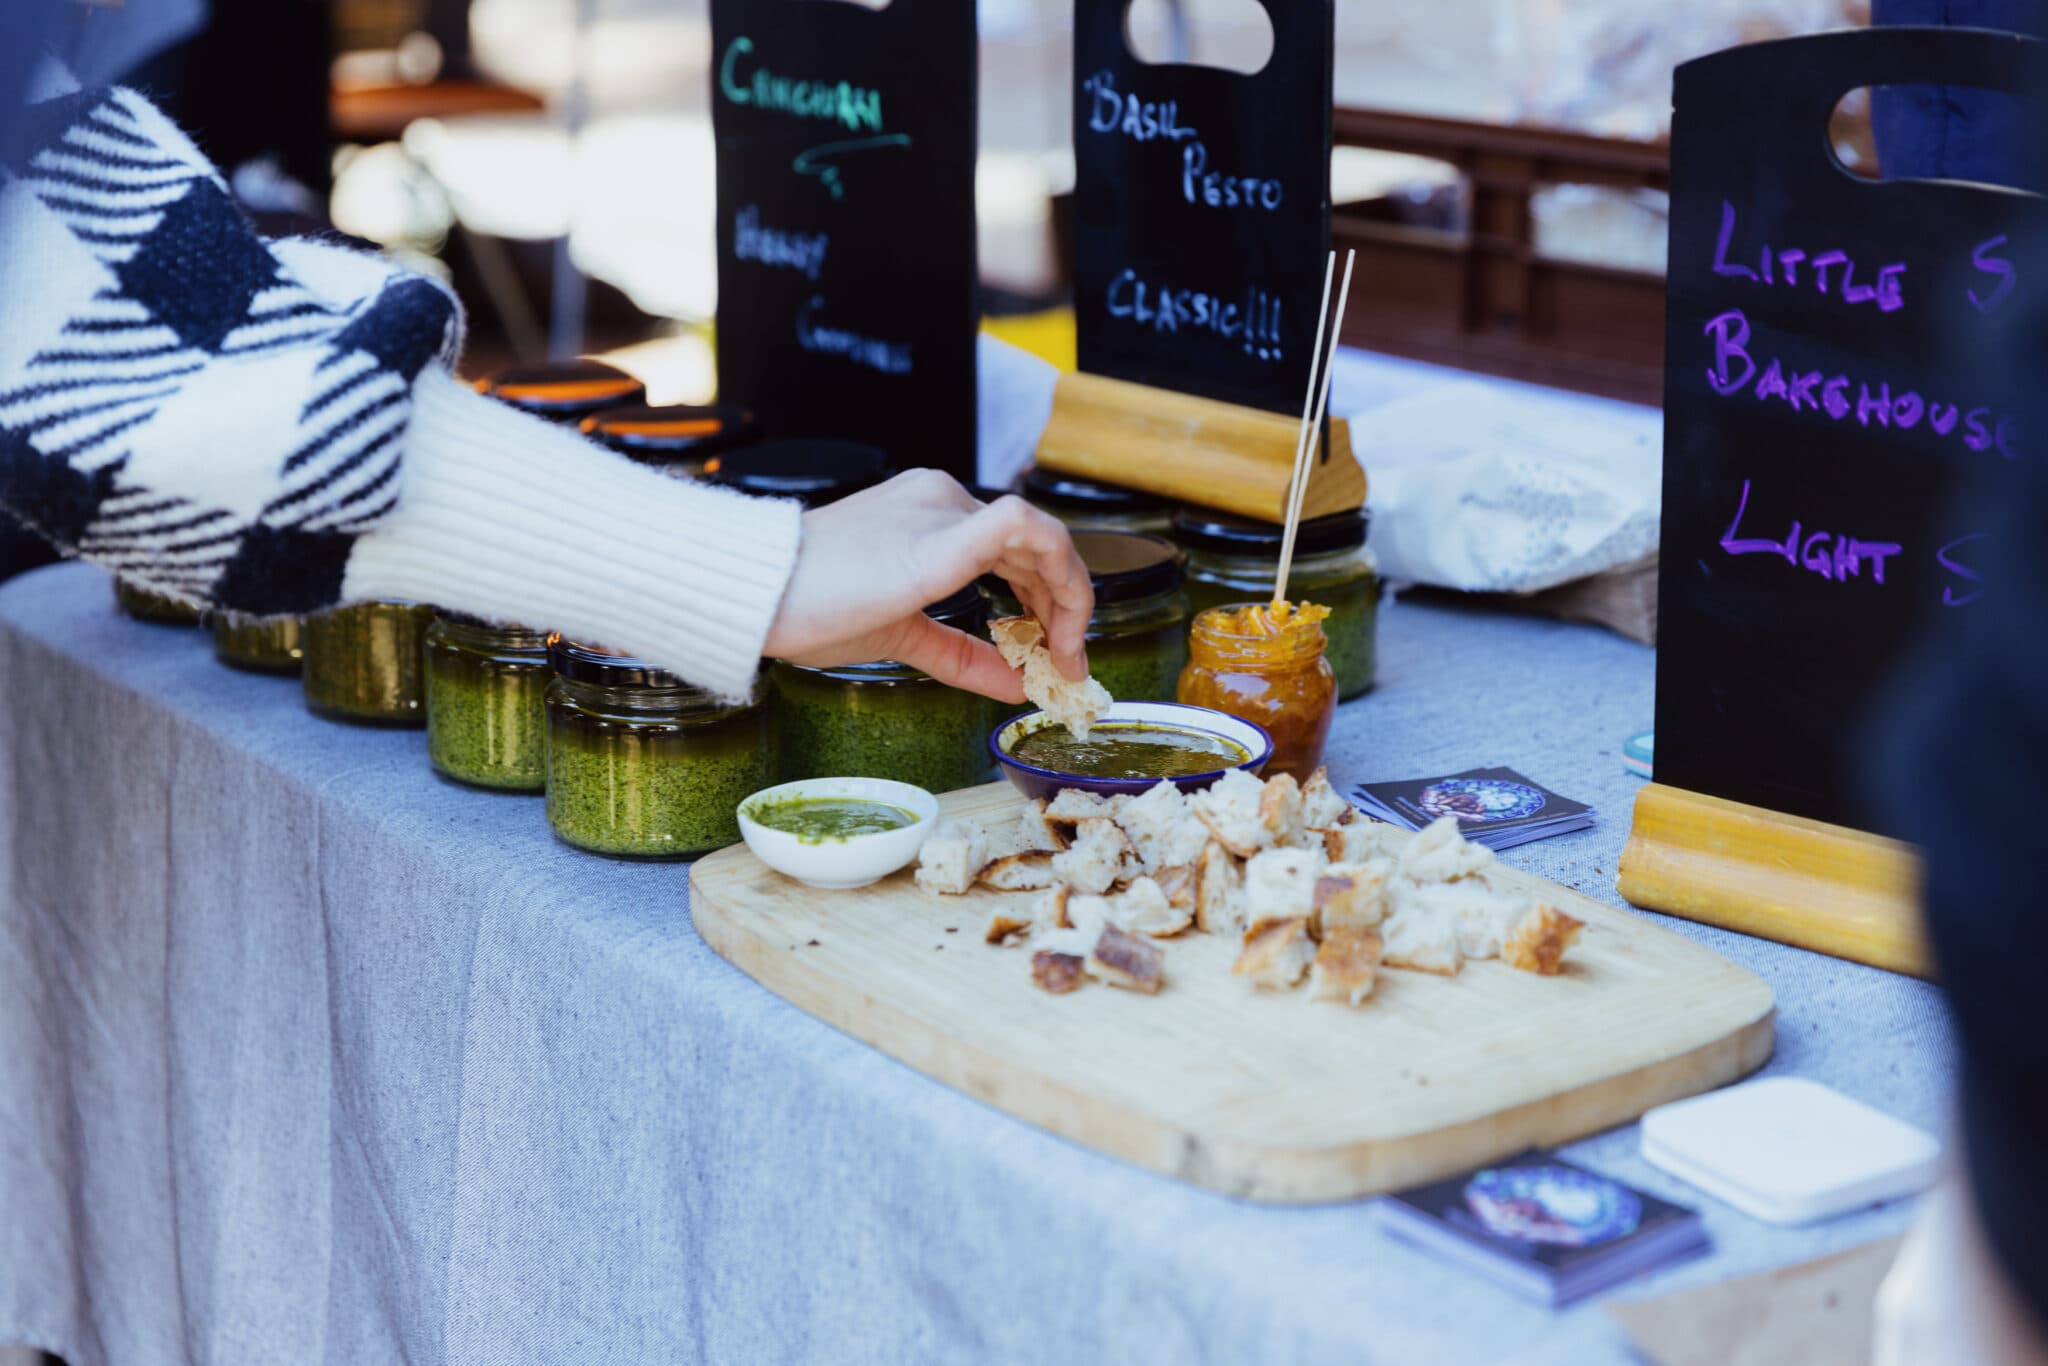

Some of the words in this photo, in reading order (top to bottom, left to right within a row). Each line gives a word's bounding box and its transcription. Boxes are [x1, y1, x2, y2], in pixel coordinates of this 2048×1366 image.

[1083, 69, 1198, 141] BASIL
[1183, 141, 1283, 210] PESTO
[1712, 200, 1906, 312] LITTLE
[1719, 479, 1904, 584] LIGHT
